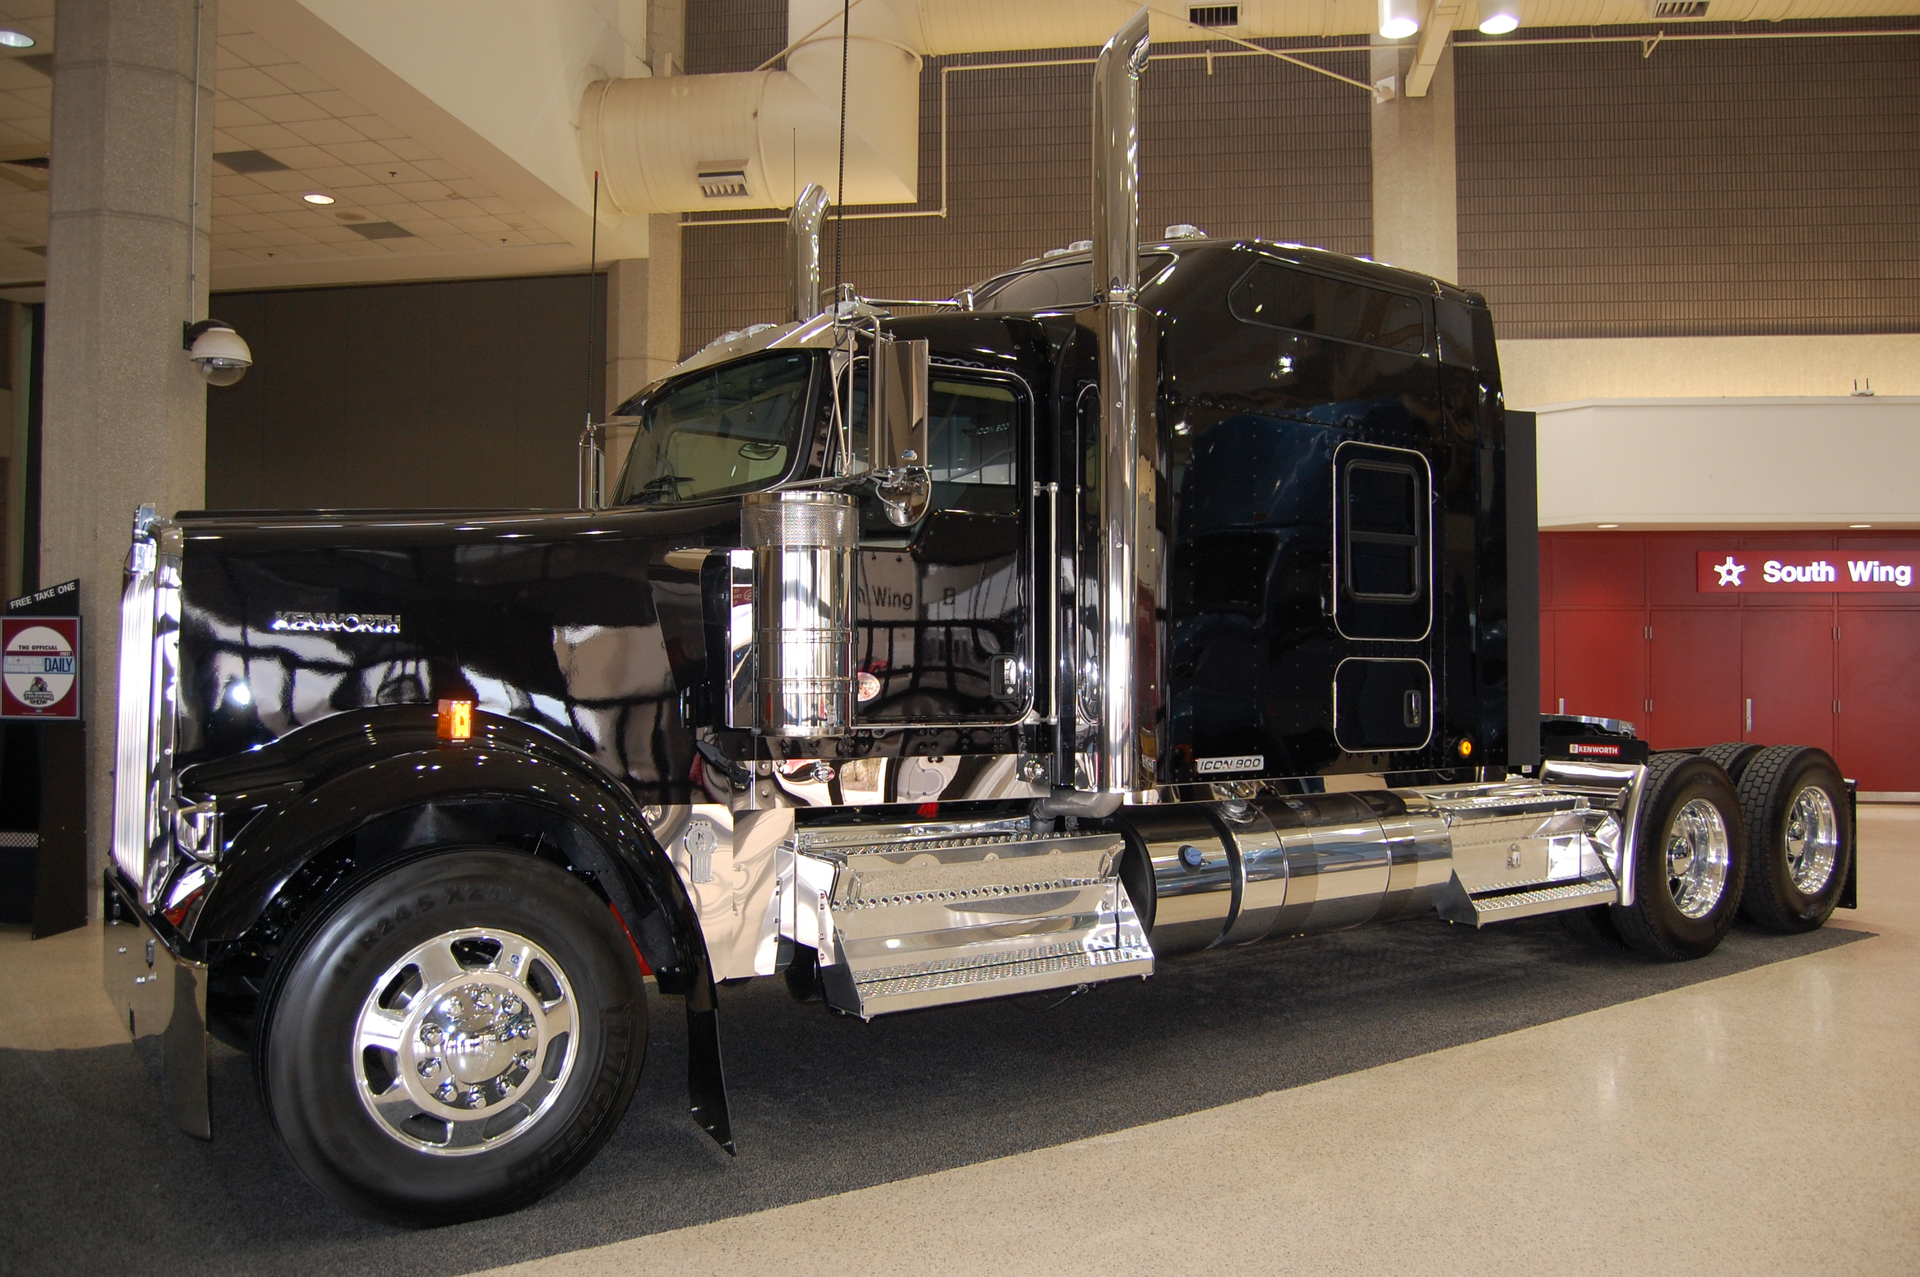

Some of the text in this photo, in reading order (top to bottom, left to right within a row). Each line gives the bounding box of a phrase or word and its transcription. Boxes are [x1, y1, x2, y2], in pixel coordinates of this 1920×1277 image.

[1763, 560, 1911, 587] South Wing
[10, 581, 76, 610] FREE TAKE ONE
[872, 586, 913, 610] Wing
[272, 610, 401, 634] KENWORTH
[44, 657, 73, 673] DAILY
[1578, 745, 1618, 754] KENWORTH
[1200, 758, 1260, 771] ICON 900
